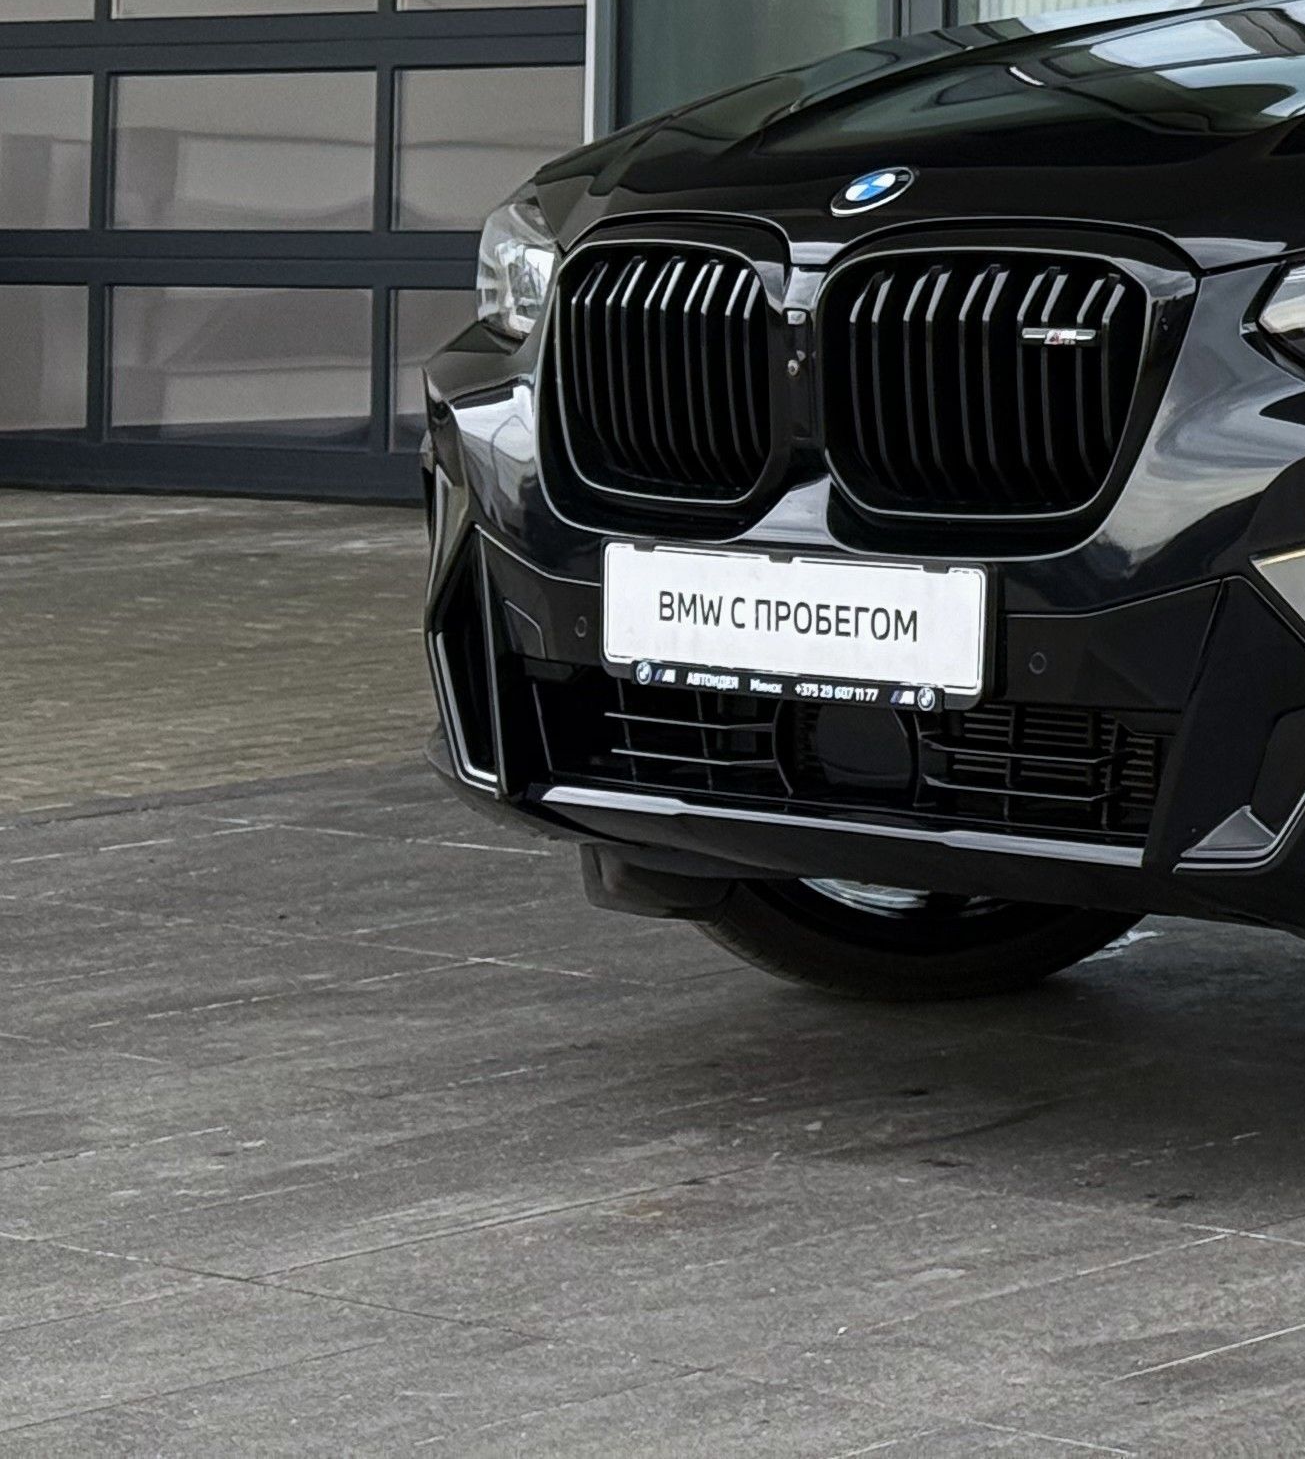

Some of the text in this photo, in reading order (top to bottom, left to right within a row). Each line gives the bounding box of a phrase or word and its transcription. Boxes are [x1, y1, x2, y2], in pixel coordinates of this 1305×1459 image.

[659, 590, 918, 643] BMW С ПРОБЕГОМ
[855, 688, 864, 701] 11
[865, 688, 879, 703] 77
